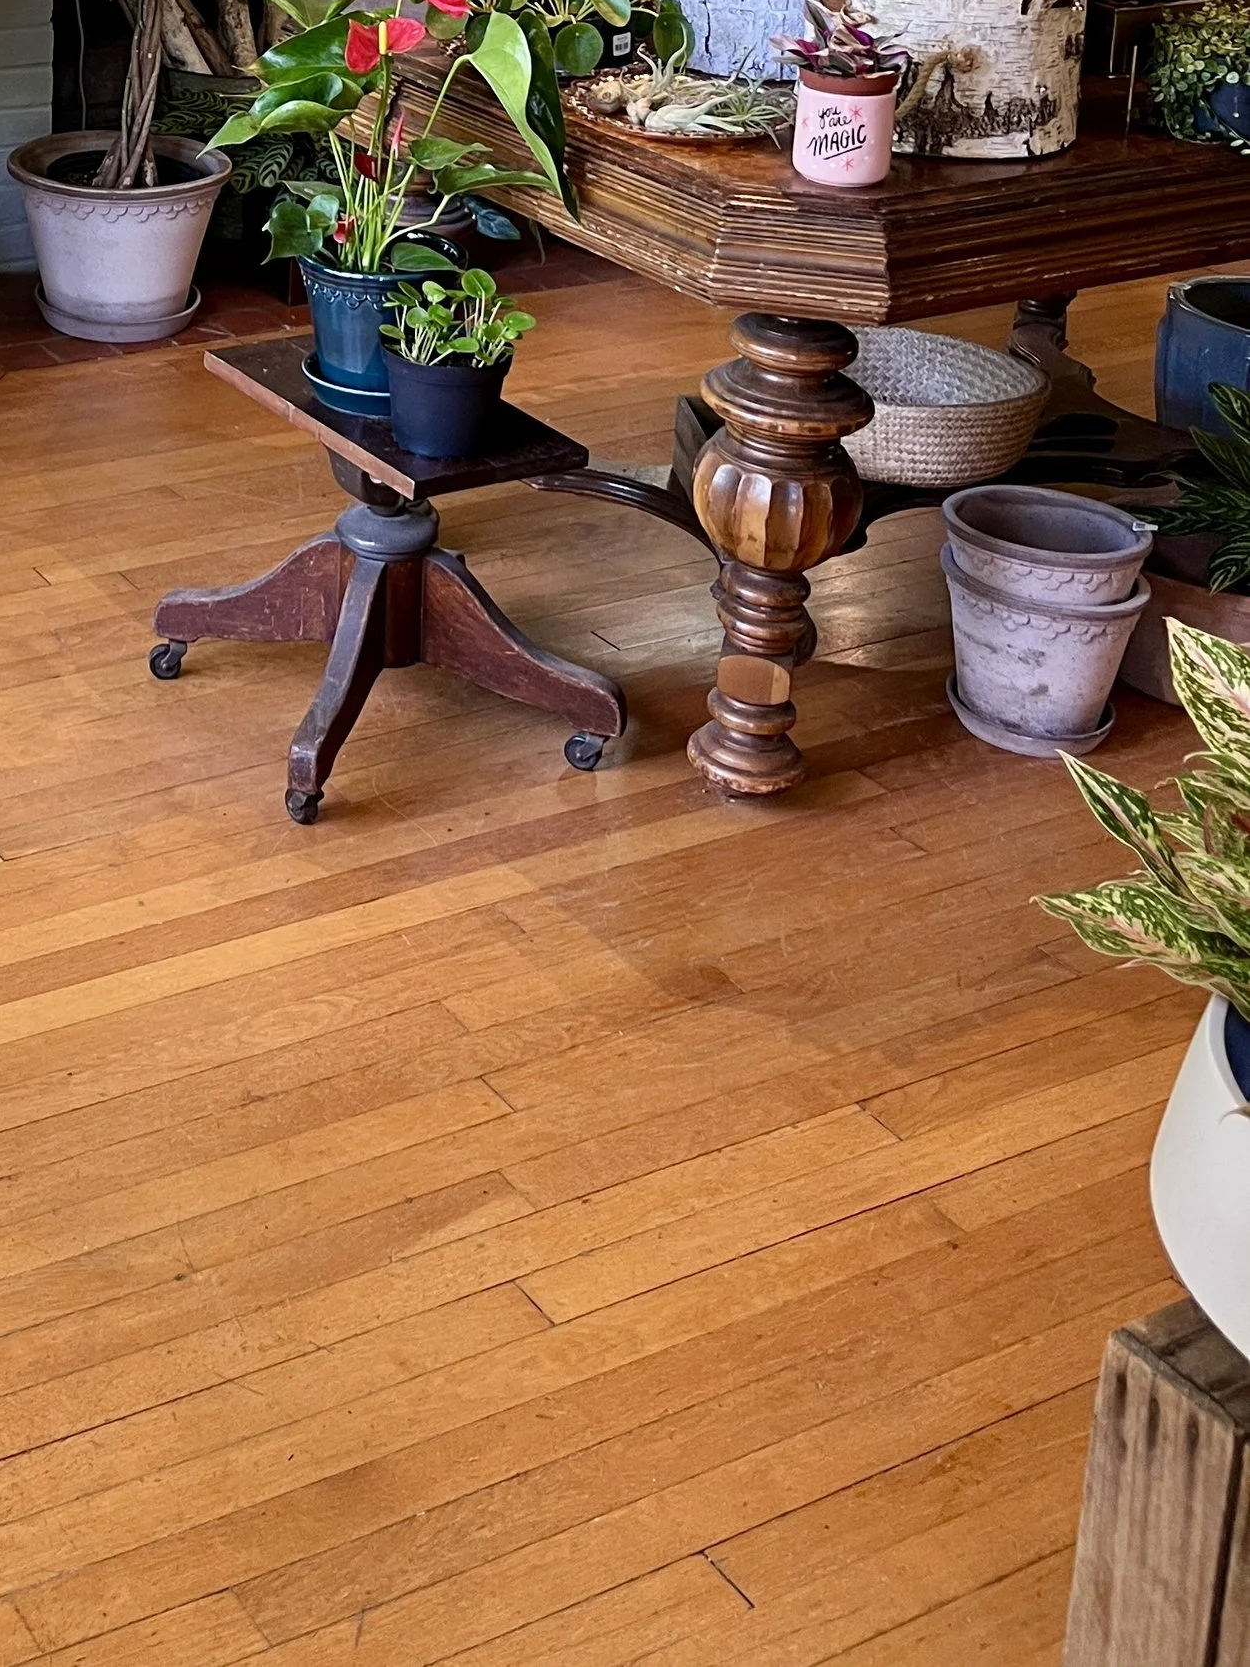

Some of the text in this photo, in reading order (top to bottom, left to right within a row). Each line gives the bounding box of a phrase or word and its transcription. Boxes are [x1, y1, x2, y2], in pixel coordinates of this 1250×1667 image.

[817, 104, 842, 129] you
[828, 115, 853, 128] are
[806, 124, 867, 158] MAGIC
